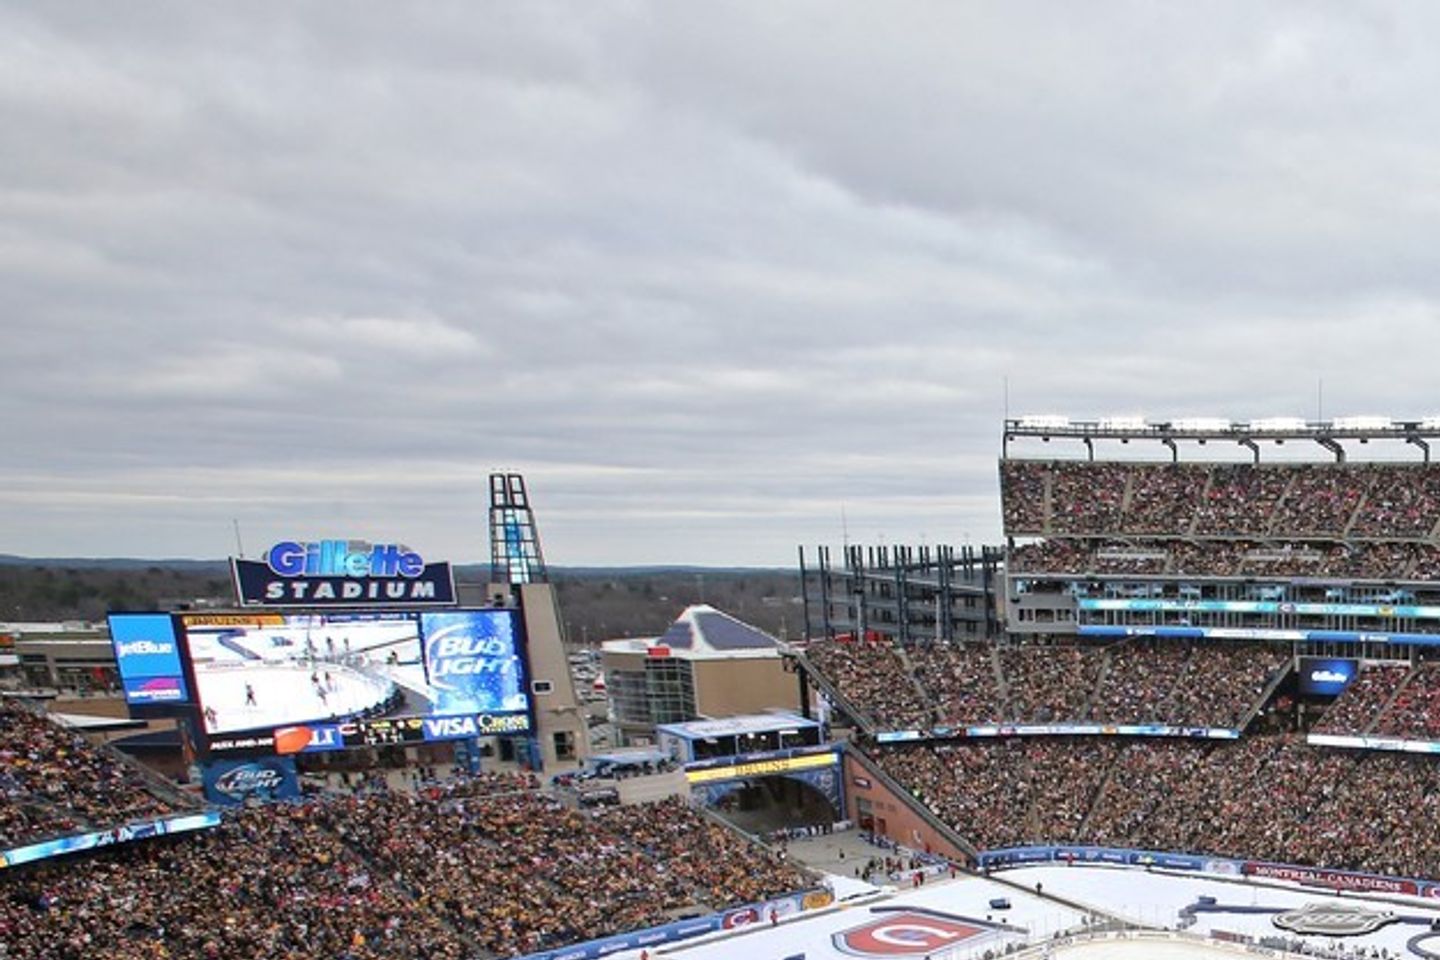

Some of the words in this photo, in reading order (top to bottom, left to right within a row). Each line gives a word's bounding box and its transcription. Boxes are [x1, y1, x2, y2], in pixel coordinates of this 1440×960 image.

[267, 540, 425, 577] Gillette
[265, 581, 435, 598] STADIUM
[116, 640, 172, 657] jetBlue
[437, 637, 506, 657] BUD
[432, 658, 514, 675] LIGHT
[427, 717, 477, 737] VISA
[1256, 866, 1322, 882] MONTREAL
[1327, 872, 1402, 891] CANADIENS
